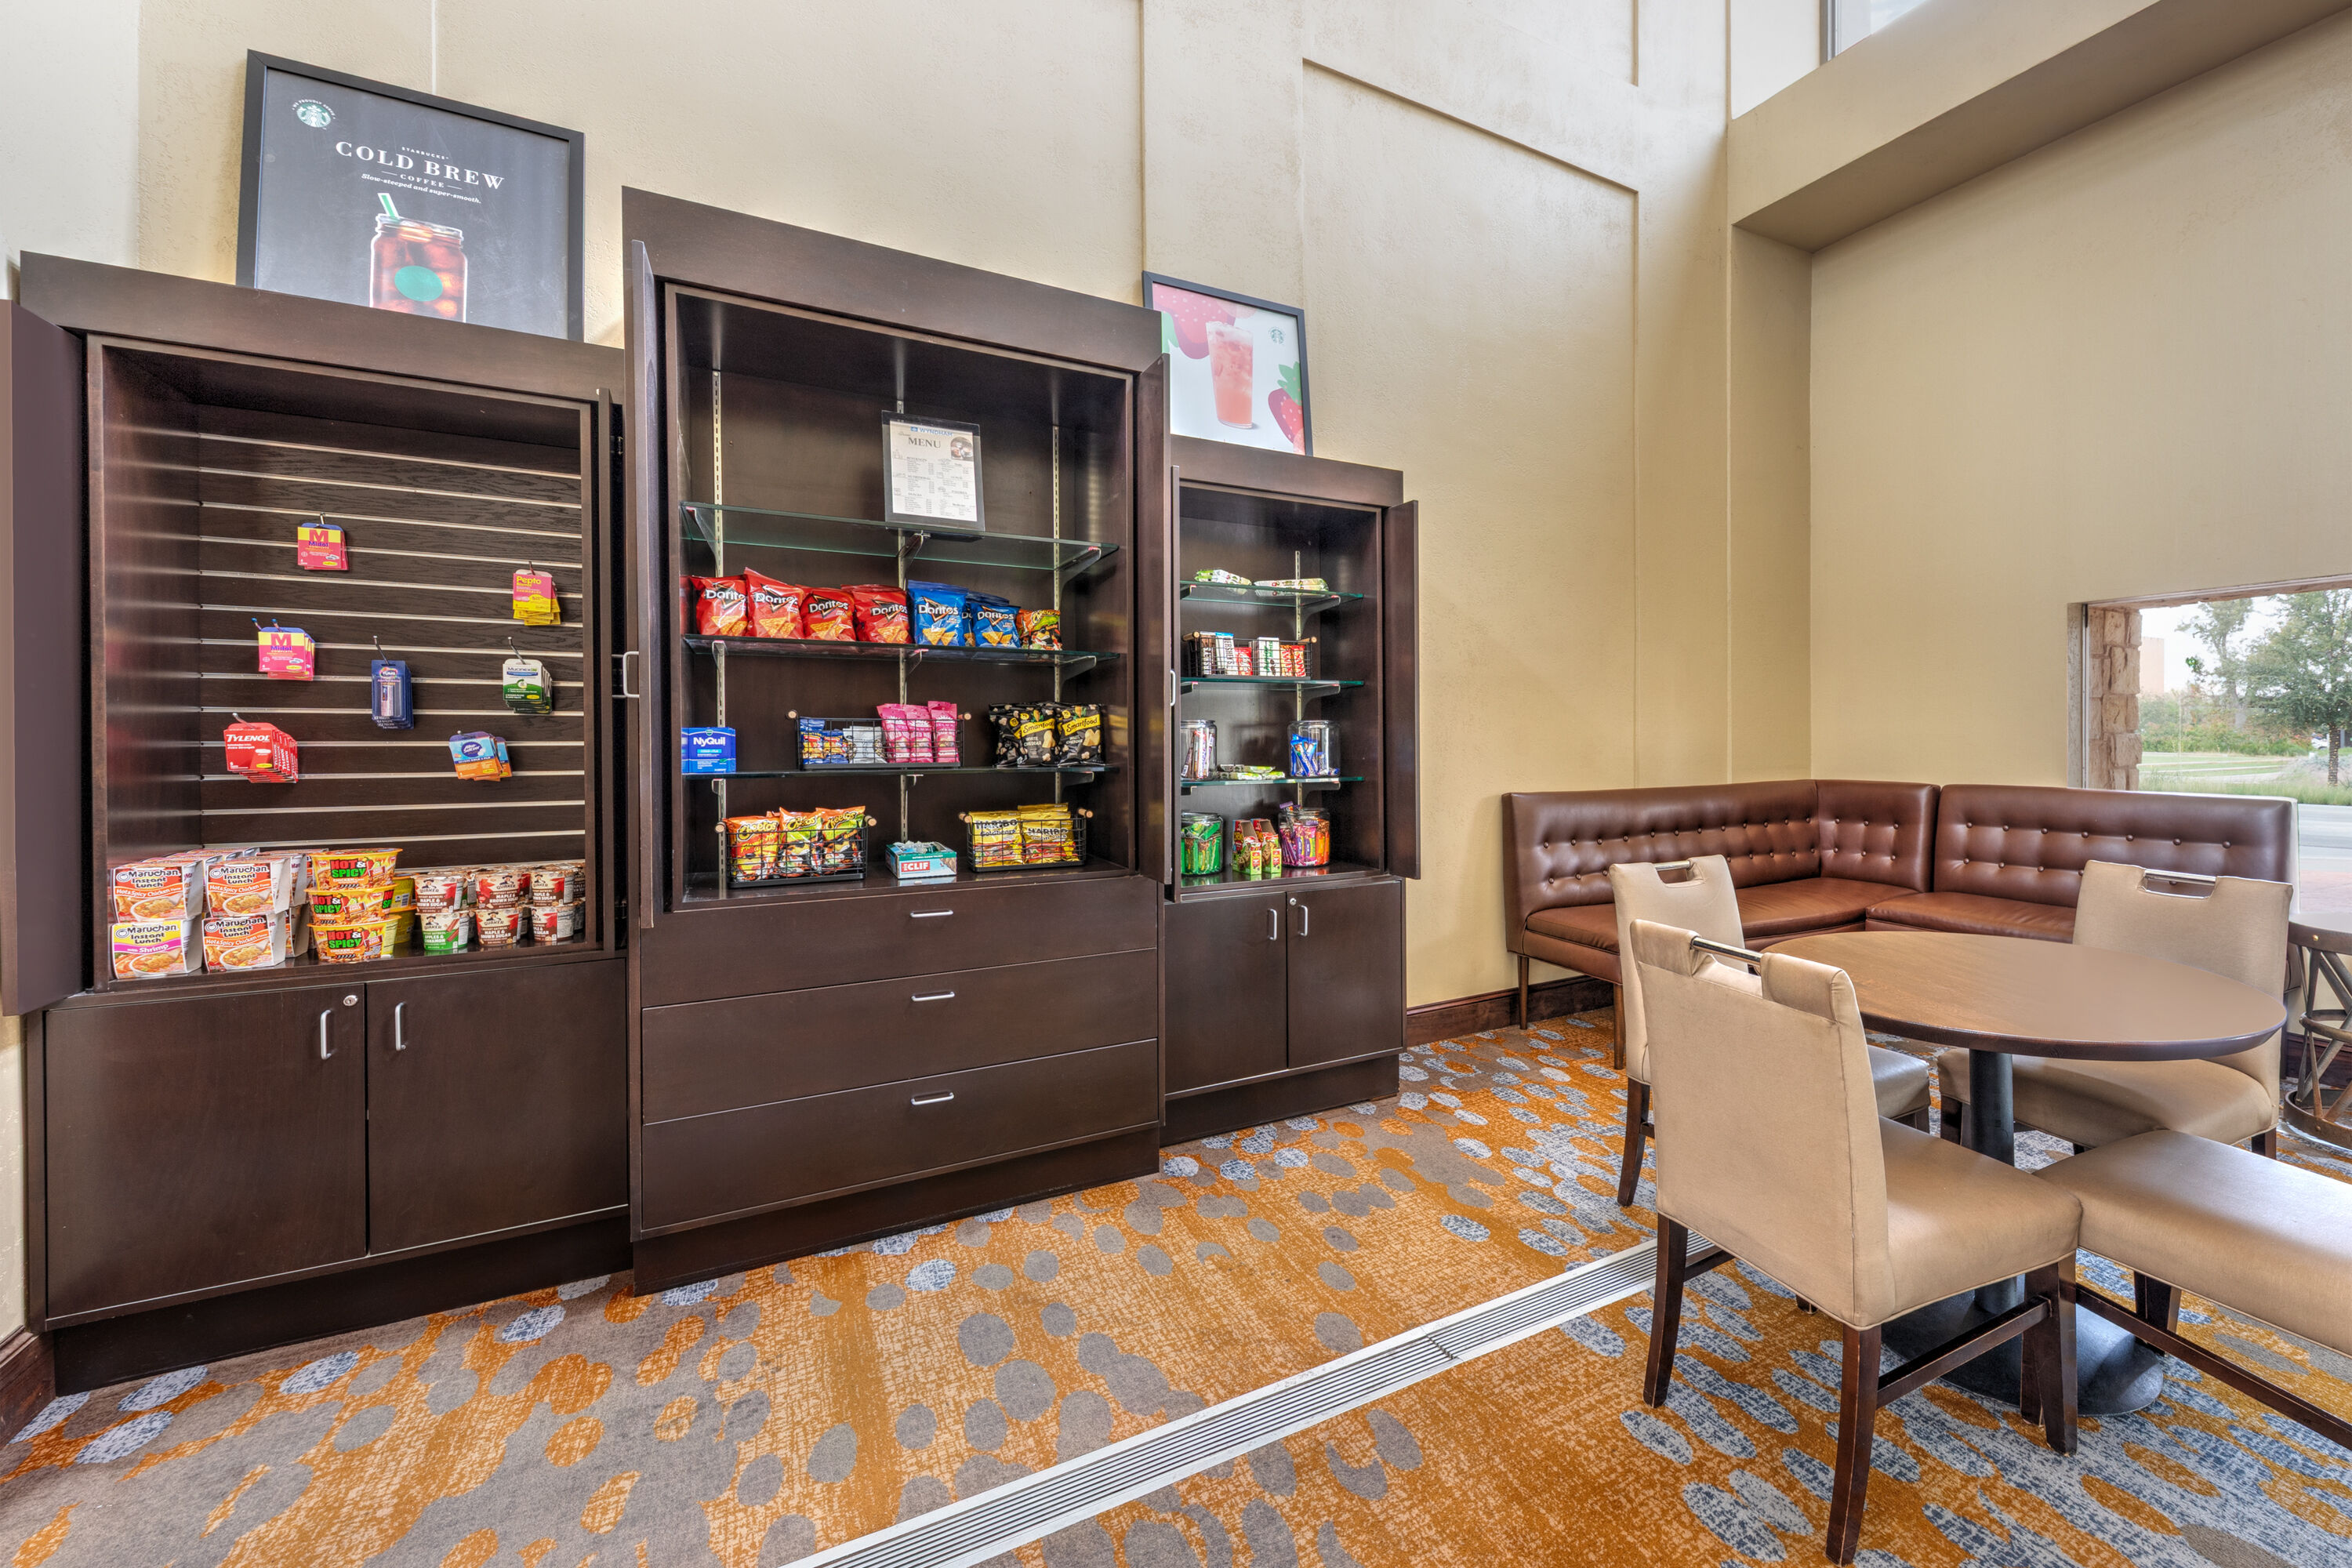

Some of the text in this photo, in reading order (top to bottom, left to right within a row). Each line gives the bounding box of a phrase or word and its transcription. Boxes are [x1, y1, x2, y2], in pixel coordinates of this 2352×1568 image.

[336, 141, 505, 190] COLD BREW
[400, 173, 445, 188] COFFEE
[361, 172, 482, 205] Slow-steeped and super-smooth.
[919, 427, 953, 437] WYNDHAM
[908, 437, 941, 449] MENU
[309, 529, 329, 542] M
[516, 575, 542, 585] Pepto
[753, 592, 799, 604] Doritos
[808, 600, 849, 614] Doritos
[871, 604, 908, 617] Doritos
[918, 604, 959, 615] Doritos
[977, 611, 1014, 621] Doritos
[270, 633, 292, 646] M
[1282, 649, 1294, 673] TWIX
[1294, 653, 1306, 677] TWIX
[1065, 718, 1098, 733] Smartfood
[226, 734, 270, 743] TYLENOL
[693, 736, 726, 747] NyQuil
[825, 811, 858, 829] Cheetos
[975, 819, 1018, 829] HARIBO
[738, 820, 778, 840] Cheetos
[1027, 827, 1069, 837] HARIBO
[329, 858, 358, 869] HOT
[907, 862, 929, 871] CLIF
[220, 866, 267, 874] Maruchan
[331, 868, 366, 878] SPICY
[147, 887, 170, 897] Chicken
[313, 895, 332, 905] HOT
[314, 904, 341, 913] SPICY
[216, 917, 263, 927] Maruchan
[127, 924, 176, 934] Maruchan
[326, 928, 354, 940] HOT
[235, 935, 257, 946] Chicken
[328, 938, 362, 949] SPICY
[139, 943, 169, 953] Shrimp
